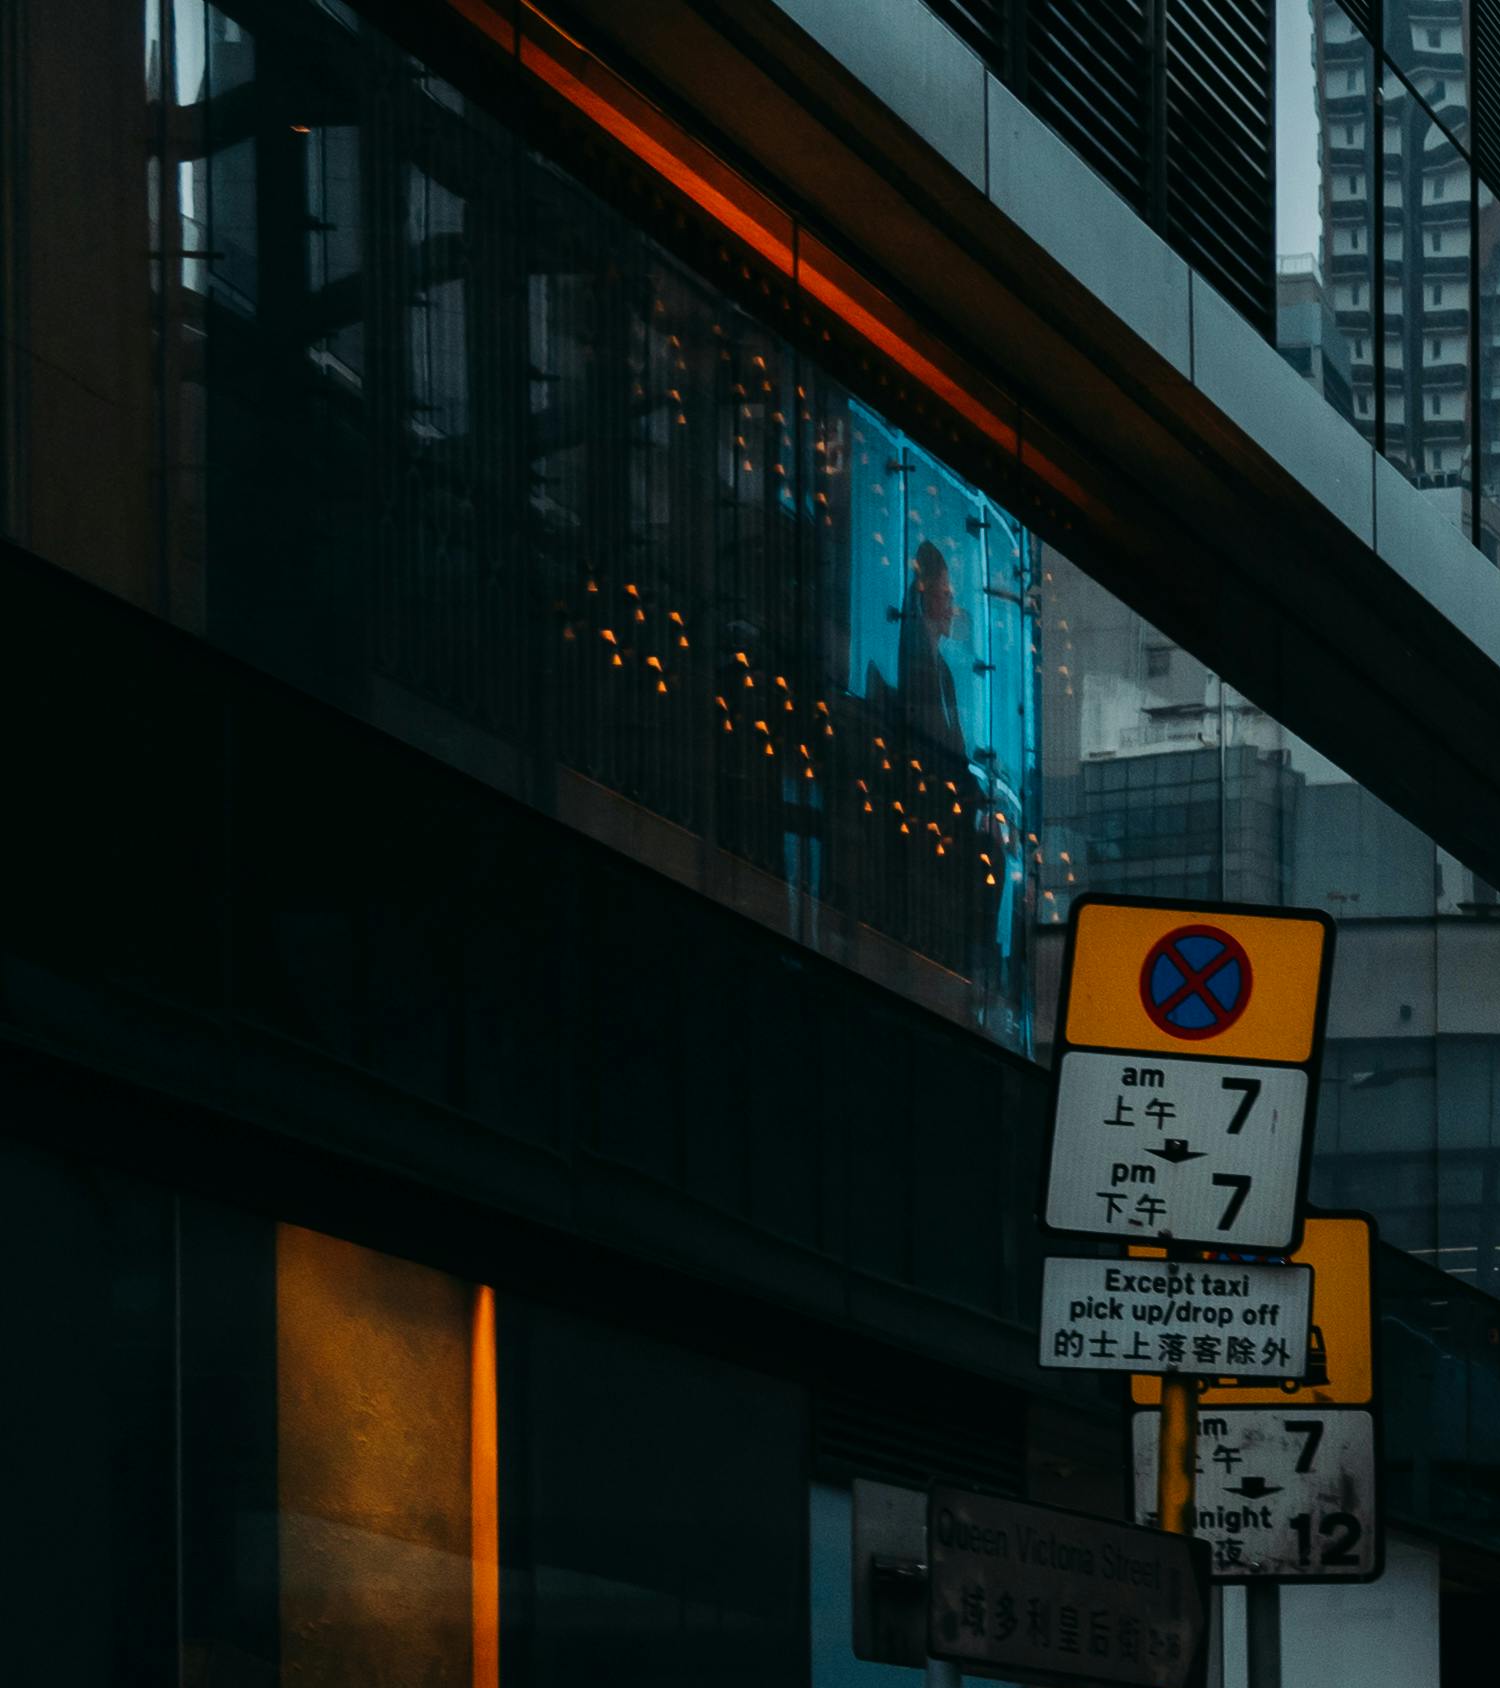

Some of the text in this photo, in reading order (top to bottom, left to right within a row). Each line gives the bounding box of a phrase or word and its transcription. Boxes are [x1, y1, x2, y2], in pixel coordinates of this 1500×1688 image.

[1121, 1066, 1165, 1088] am
[1103, 1094, 1177, 1131] 上午
[1221, 1076, 1262, 1135] 7
[1111, 1162, 1156, 1187] pm
[1096, 1191, 1167, 1227] 下午
[1211, 1172, 1252, 1232] 7
[1105, 1268, 1250, 1298] Except taxi
[1069, 1296, 1281, 1328] pick up/drop off
[1054, 1328, 1291, 1367] 的士上落客除外
[1197, 1417, 1228, 1437] m
[1283, 1420, 1324, 1474] 7
[936, 1507, 1161, 1591] Queen Victoria Street
[1214, 1537, 1245, 1568] 夜
[1289, 1511, 1363, 1567] 12
